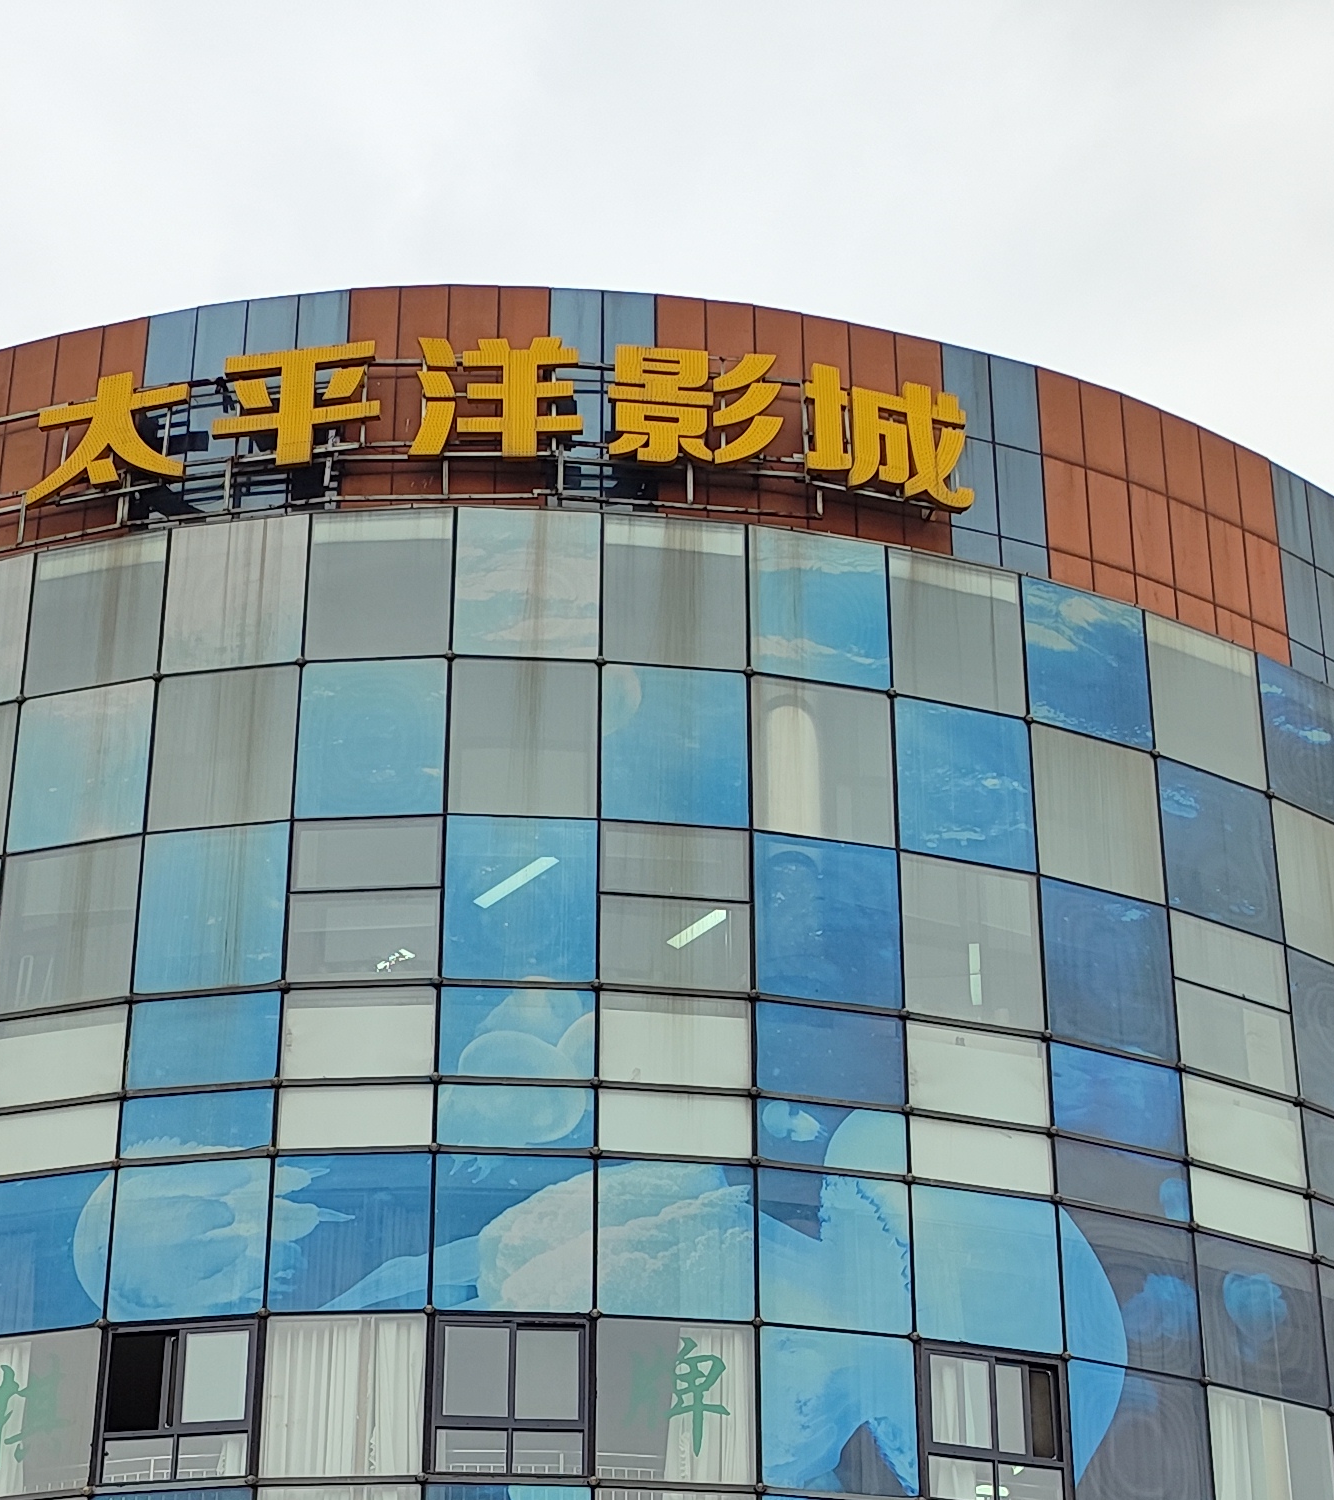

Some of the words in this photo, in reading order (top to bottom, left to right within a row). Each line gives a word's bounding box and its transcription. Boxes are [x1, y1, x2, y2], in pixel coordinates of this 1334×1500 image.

[24, 336, 975, 513] 太平洋影城
